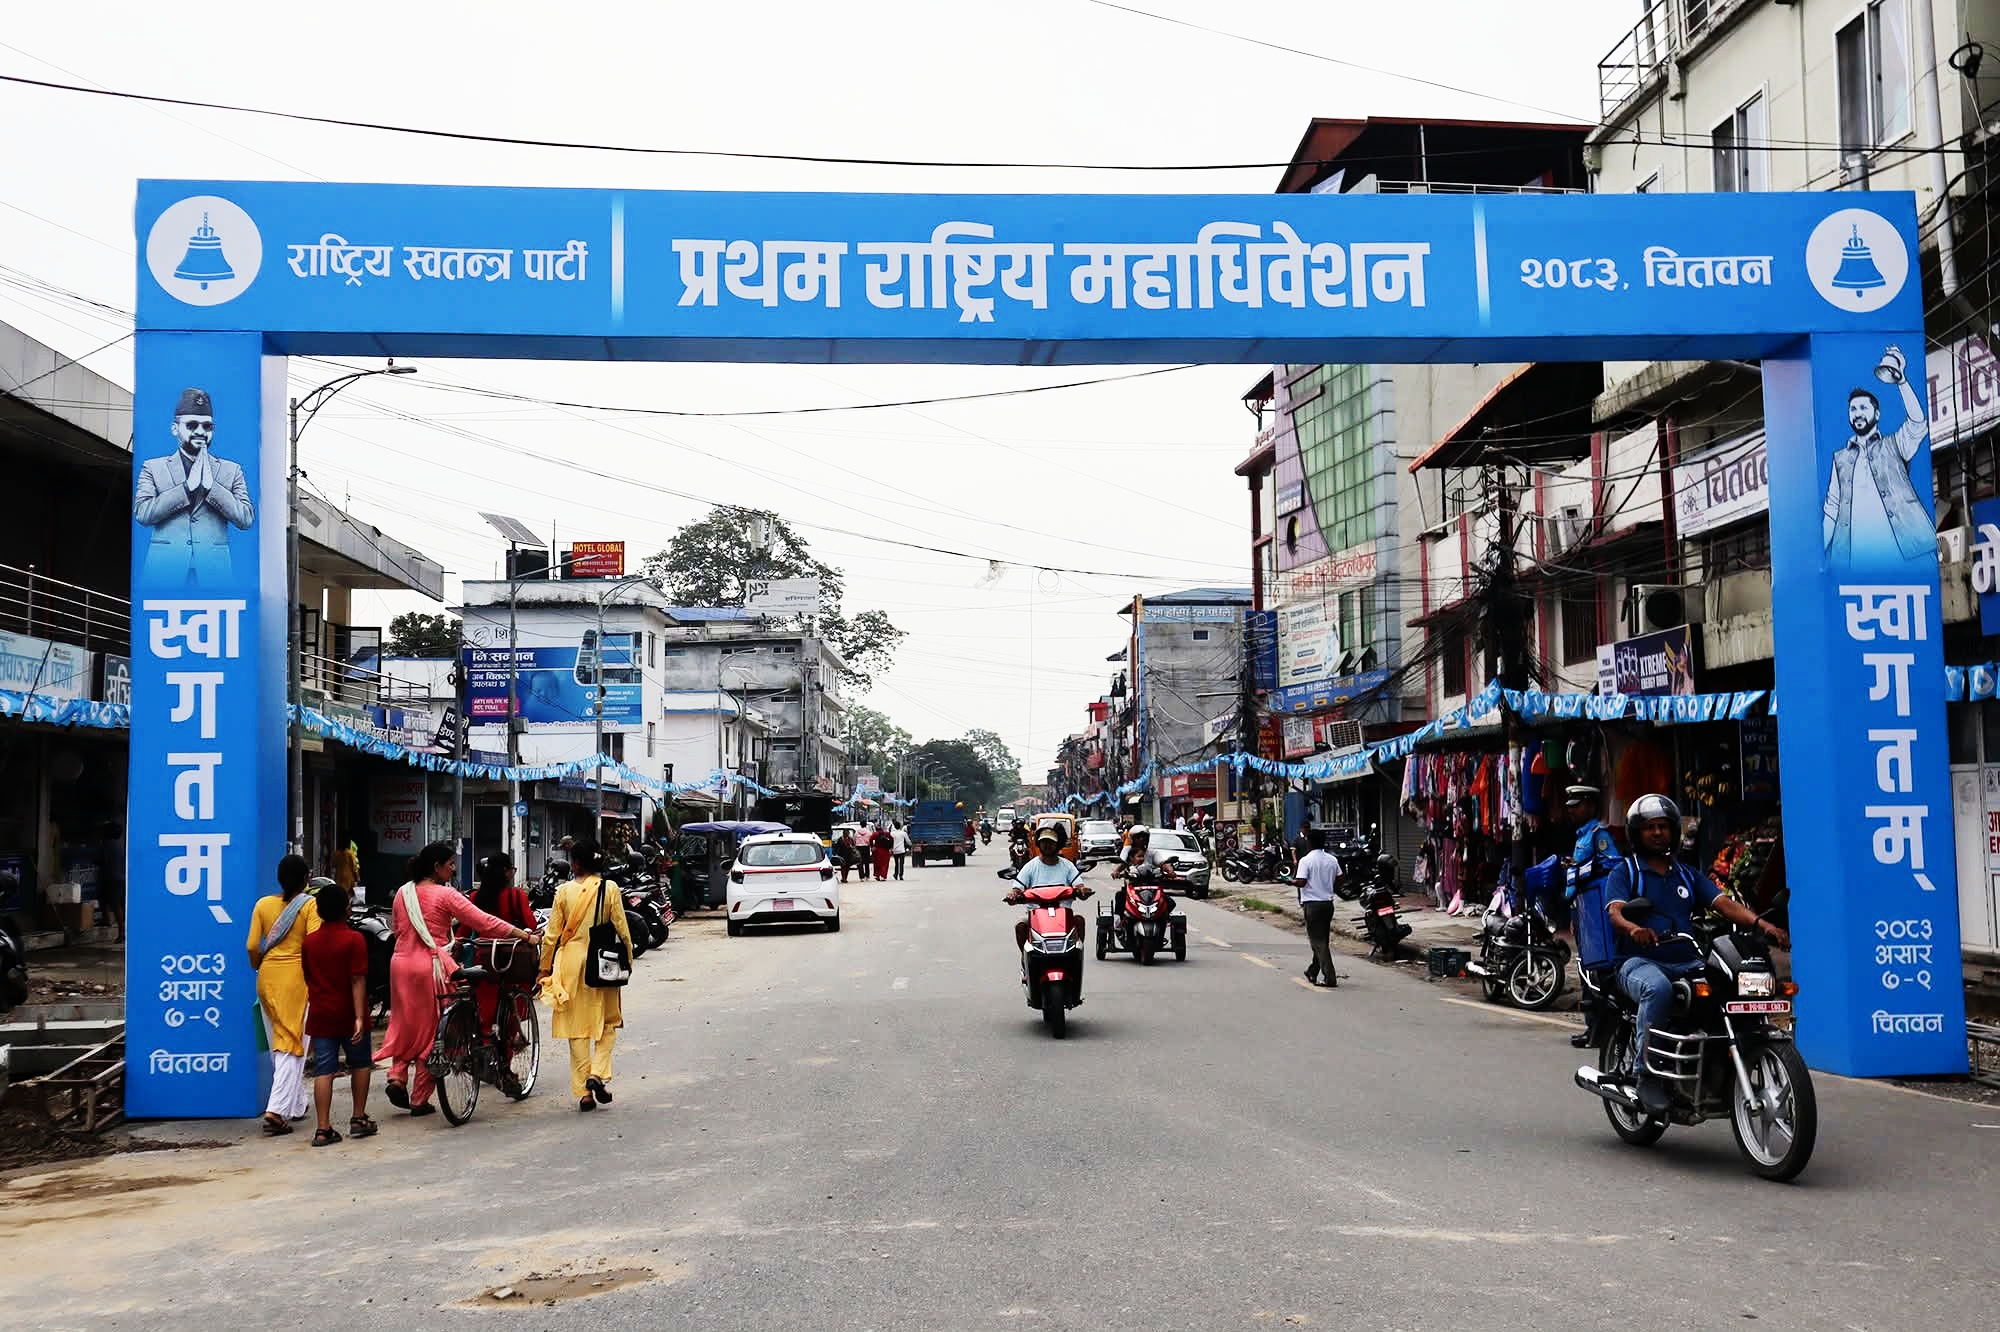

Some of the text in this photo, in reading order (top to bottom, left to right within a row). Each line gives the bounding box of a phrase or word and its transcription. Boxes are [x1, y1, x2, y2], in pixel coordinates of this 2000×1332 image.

[288, 233, 589, 287] राष्ट्रिय स्वतन्त्र पार्टी
[1643, 246, 1774, 289] चितवन
[671, 221, 1431, 323] प्रथम राष्ट्रिय महाधिवेशन
[574, 543, 623, 553] HOTEL GLOBAL
[1639, 652, 1668, 677] XTREME
[1874, 919, 1933, 939] २०८३
[161, 953, 226, 975] २०८३
[1875, 945, 1933, 965] असार
[159, 980, 225, 1002] असार
[1872, 1010, 1944, 1033] चितवन
[149, 1049, 230, 1075] चितवन
